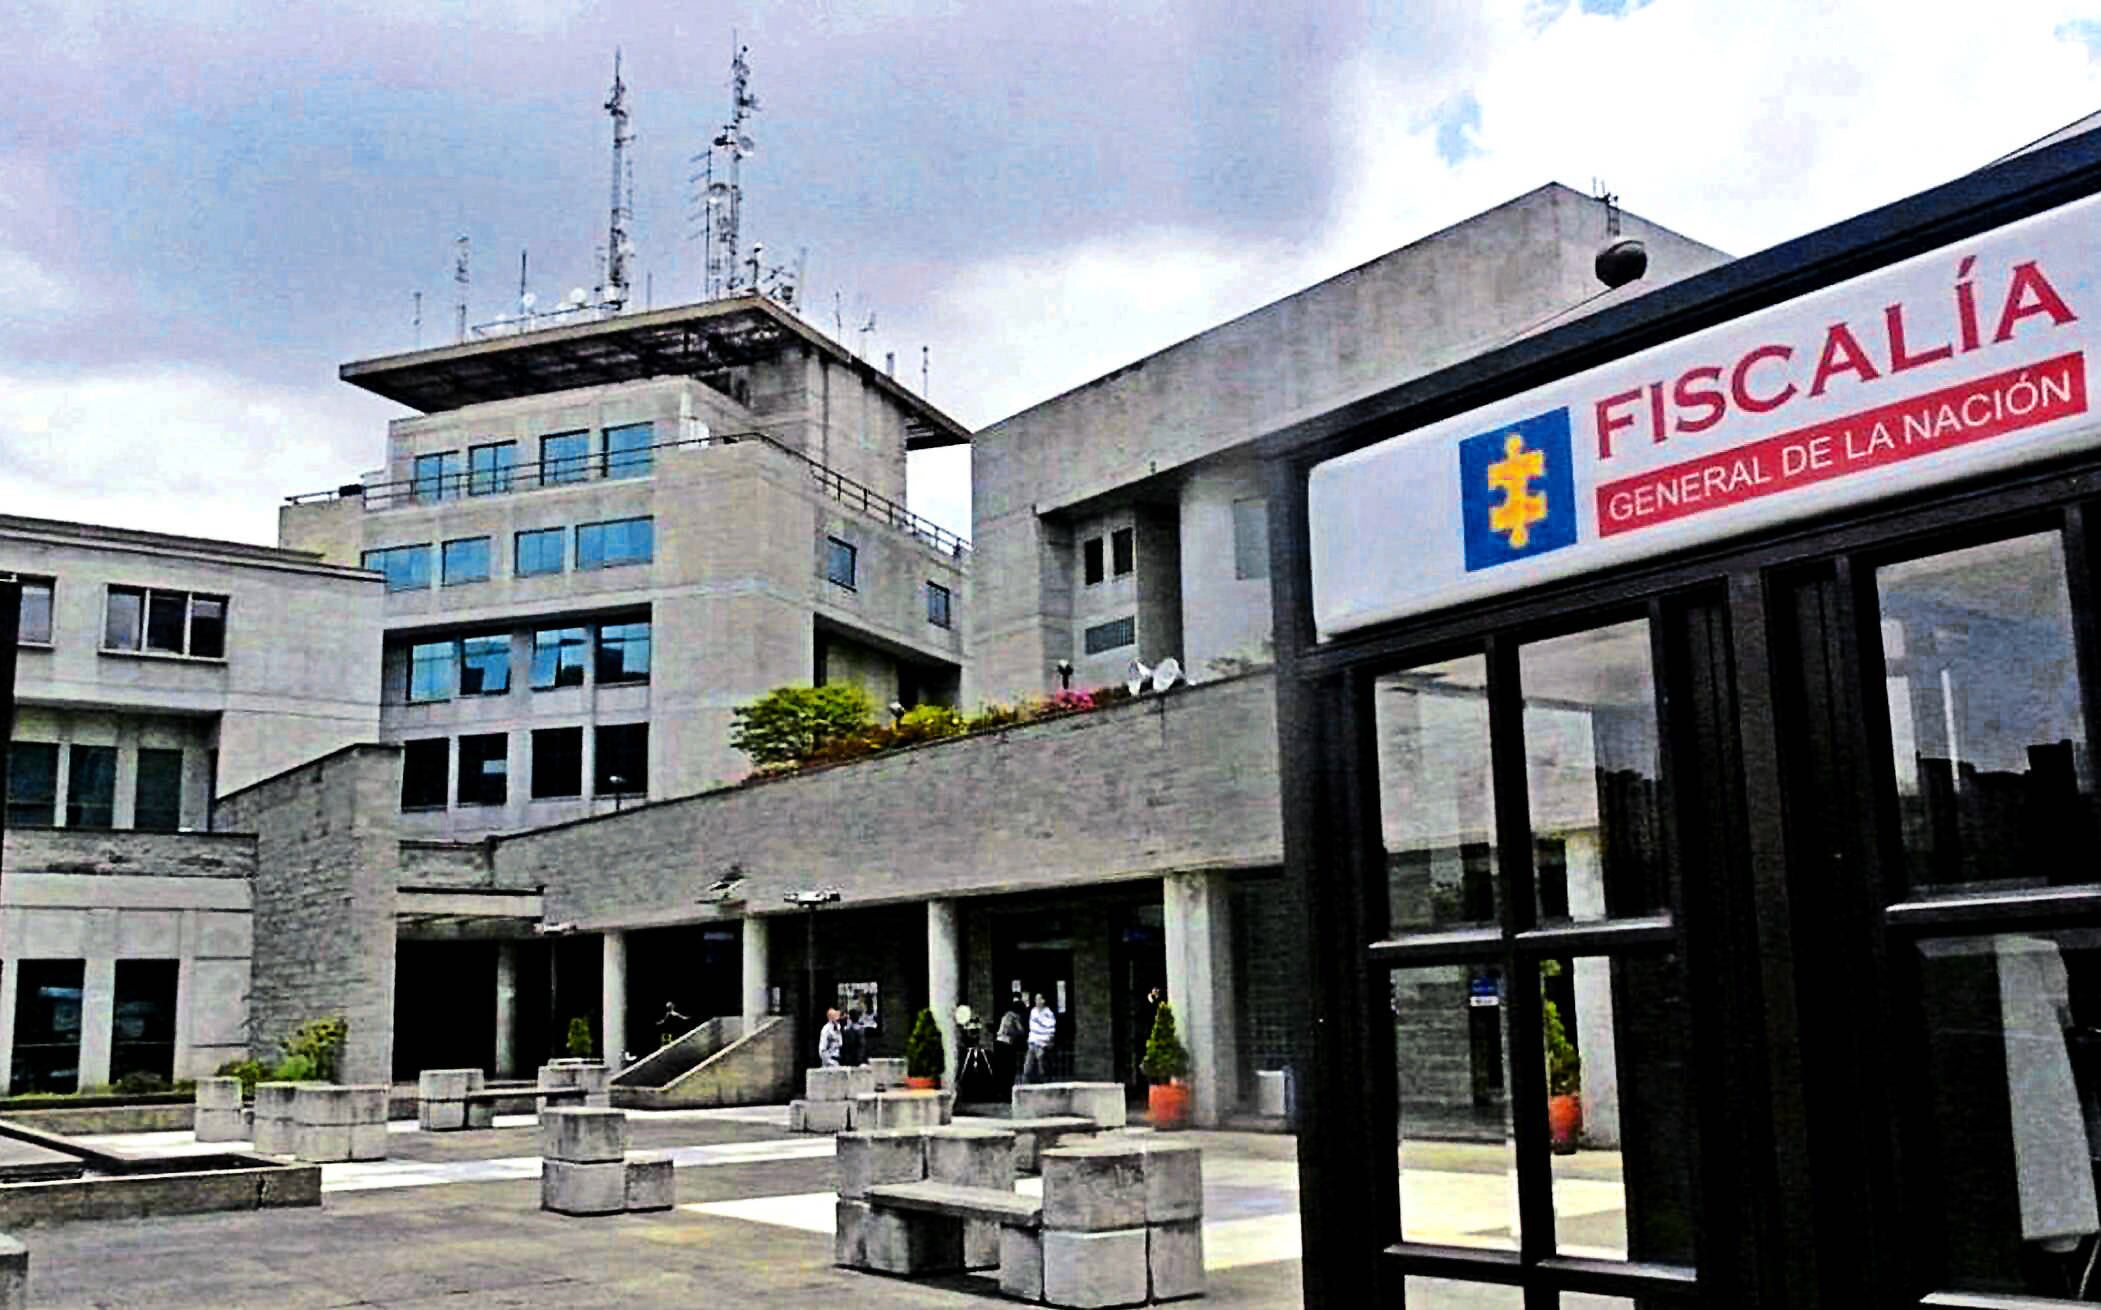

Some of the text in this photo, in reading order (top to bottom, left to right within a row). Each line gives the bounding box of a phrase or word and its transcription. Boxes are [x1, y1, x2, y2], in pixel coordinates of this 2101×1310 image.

[1595, 256, 2077, 460] FISCALÍA
[1609, 370, 2071, 521] GENERAL DE LA NACIÓN
